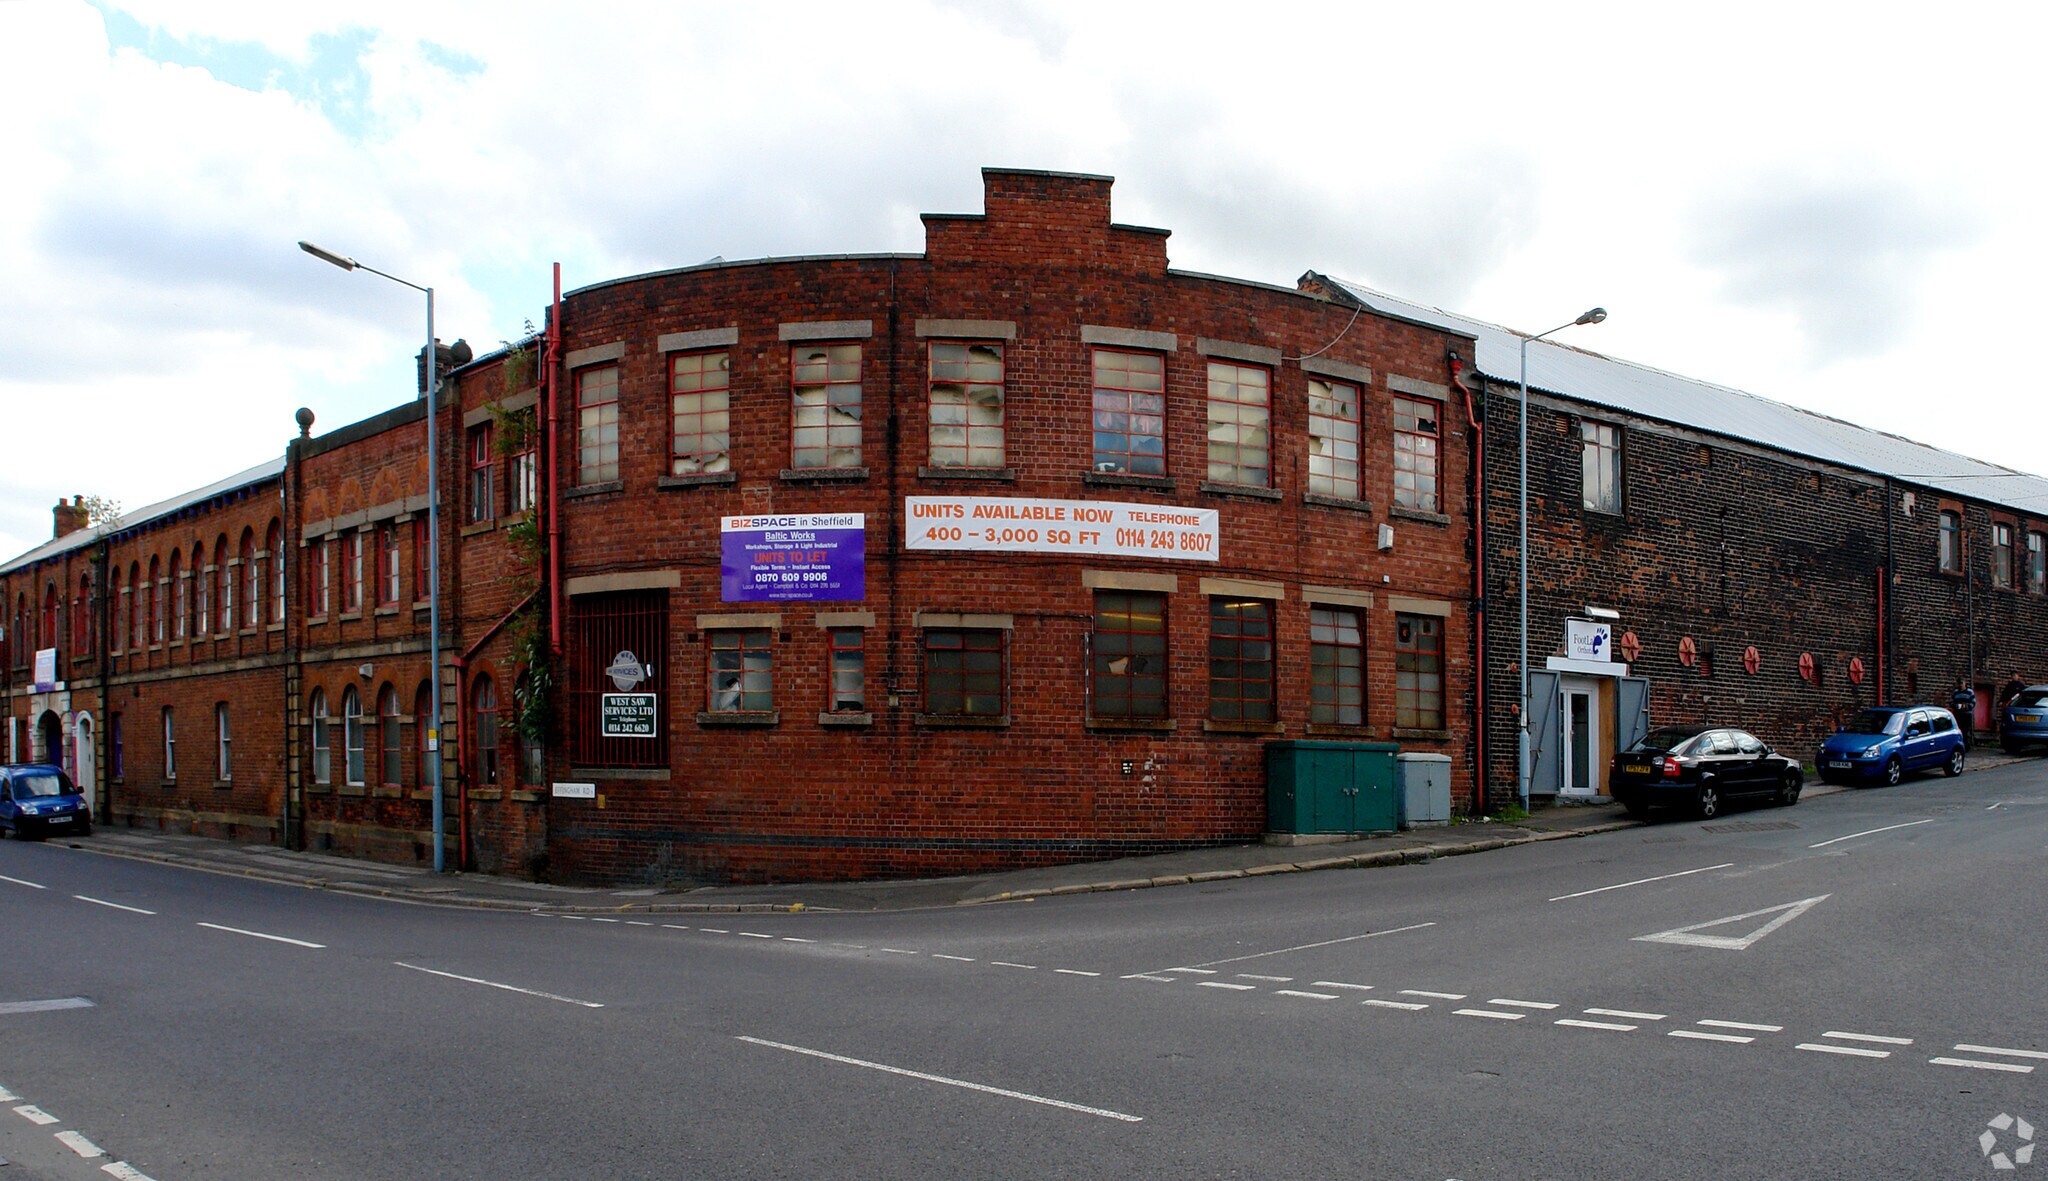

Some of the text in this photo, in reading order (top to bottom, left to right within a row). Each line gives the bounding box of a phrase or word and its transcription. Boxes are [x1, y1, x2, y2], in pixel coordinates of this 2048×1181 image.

[913, 504, 1200, 526] UNITS AVAILABLE NOW TELEPHONE
[731, 516, 853, 529] BIZSPACE in Sheffield
[765, 531, 816, 540] Baltic Works
[926, 527, 962, 541] 400
[985, 528, 1038, 544] 3,000
[1047, 530, 1071, 544] SQ
[1079, 531, 1100, 545] FT
[1116, 528, 1145, 547] 0114
[1151, 530, 1174, 550] 243
[1180, 532, 1212, 552] 8607
[754, 551, 827, 563] UNITS TO LET
[755, 572, 827, 583] 0870 609 9906
[1574, 634, 1594, 646] FootLa
[610, 698, 647, 706] WEST SAW
[605, 707, 653, 715] SERVICES LTD
